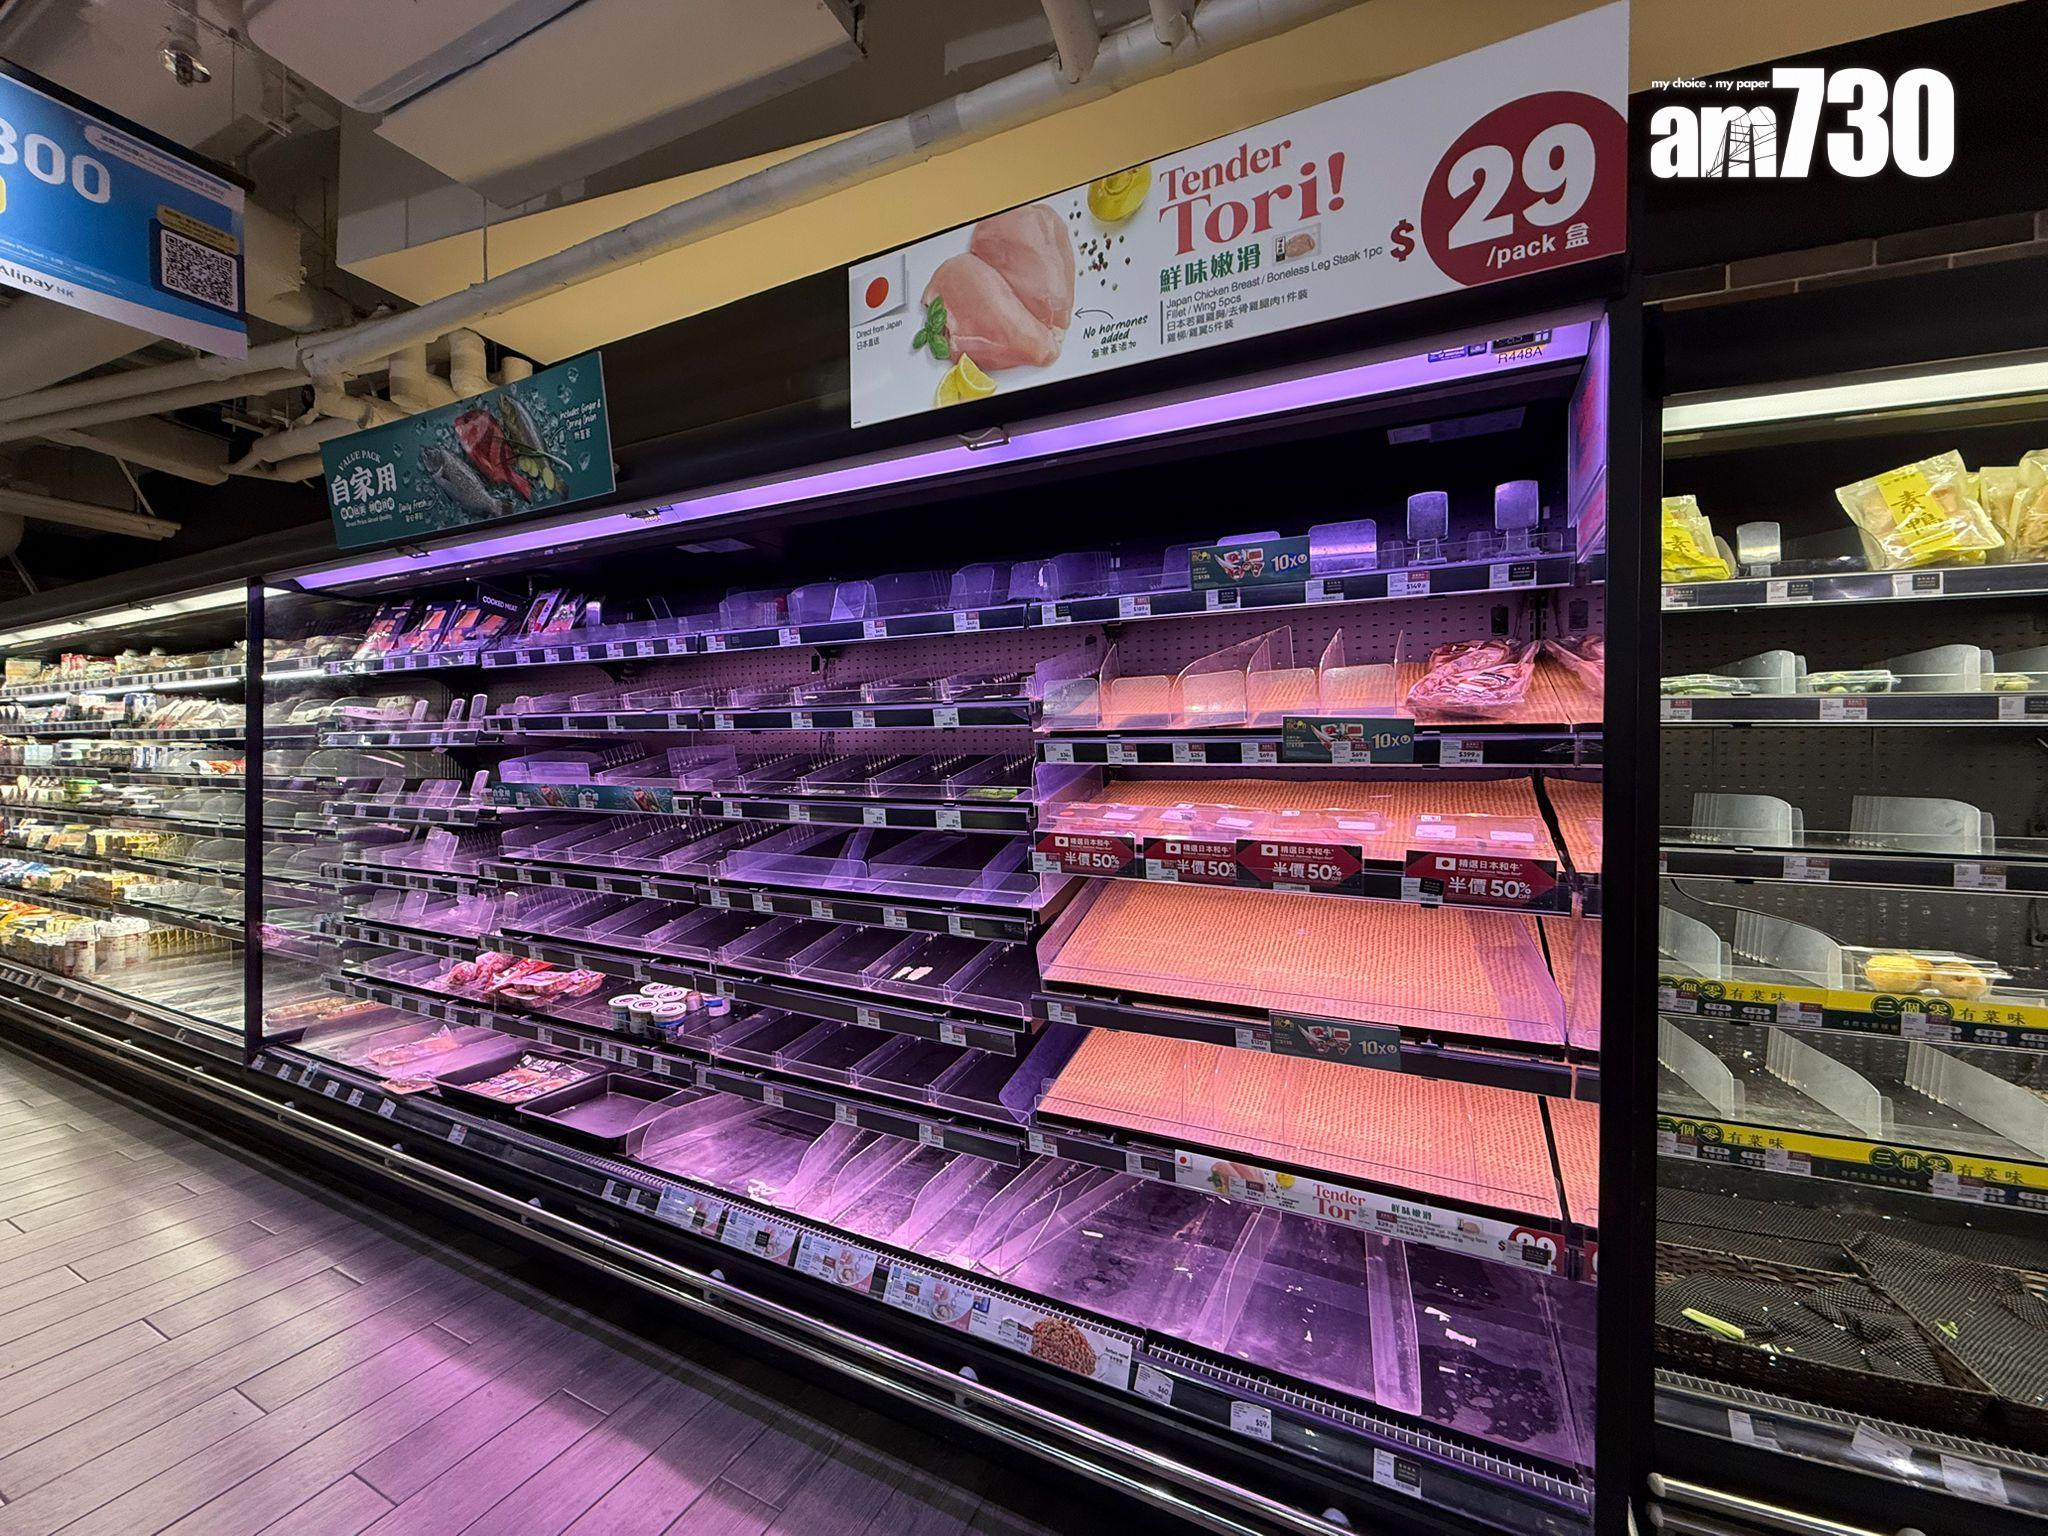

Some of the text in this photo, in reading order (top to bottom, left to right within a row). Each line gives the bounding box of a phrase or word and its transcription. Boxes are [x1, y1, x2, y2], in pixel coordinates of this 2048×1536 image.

[1159, 139, 1292, 202] Tender
[1390, 122, 1597, 262] $ 29
[1159, 152, 1346, 257] Tori!
[1486, 222, 1590, 269] /pack 盒
[1160, 243, 1261, 293] 鮮味嫩滑
[1166, 294, 1193, 309] Japan
[1194, 287, 1230, 301] Chicken
[1231, 277, 1260, 292] Breast
[1266, 266, 1310, 283] Boneless
[1311, 258, 1331, 272] Leg
[1332, 252, 1361, 266] Steak
[1364, 245, 1383, 259] 1pc
[1166, 307, 1187, 320] Fillet
[1193, 300, 1217, 313] Wing
[1218, 294, 1242, 308] 5pcs
[872, 325, 885, 334] from
[886, 320, 903, 330] Japan
[1083, 314, 1148, 339] No hormones
[1101, 328, 1130, 345] added
[1498, 347, 1543, 364] R448A
[338, 450, 380, 471] VALUE PACK
[331, 462, 397, 506] 自家用
[1065, 852, 1090, 866] 半價
[1092, 854, 1120, 868] 50%
[1177, 860, 1205, 874] 半價
[1272, 862, 1304, 878] 半價
[1308, 864, 1342, 880] 50%
[1448, 876, 1487, 896] 半價
[1490, 880, 1532, 898] 50%
[1730, 988, 1786, 1002] 有菜味
[1958, 1007, 2026, 1025] 有菜味
[1728, 1132, 1785, 1150] 有菜味
[1958, 1163, 2024, 1184] 有菜味
[1313, 1183, 1366, 1206] Tender
